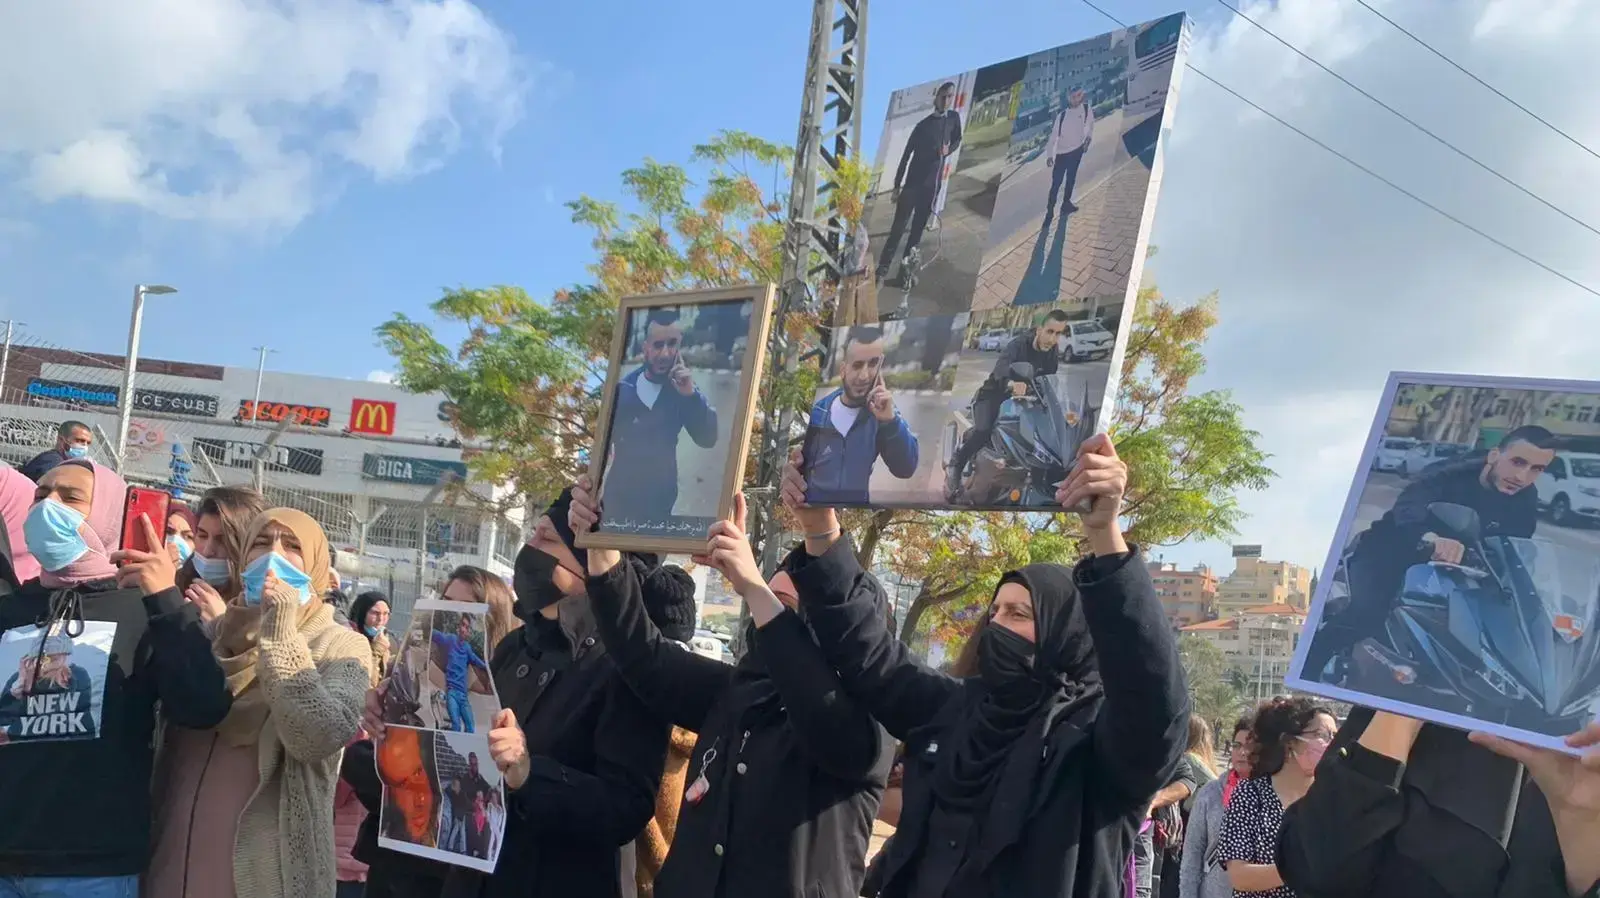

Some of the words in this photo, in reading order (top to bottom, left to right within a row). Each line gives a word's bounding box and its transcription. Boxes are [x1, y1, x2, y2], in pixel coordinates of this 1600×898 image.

[28, 382, 117, 401] Gentleman
[134, 393, 165, 407] ICE
[171, 397, 217, 412] CUBE
[377, 459, 413, 479] BIGA
[27, 691, 81, 715] NEW
[20, 711, 87, 736] YORK
